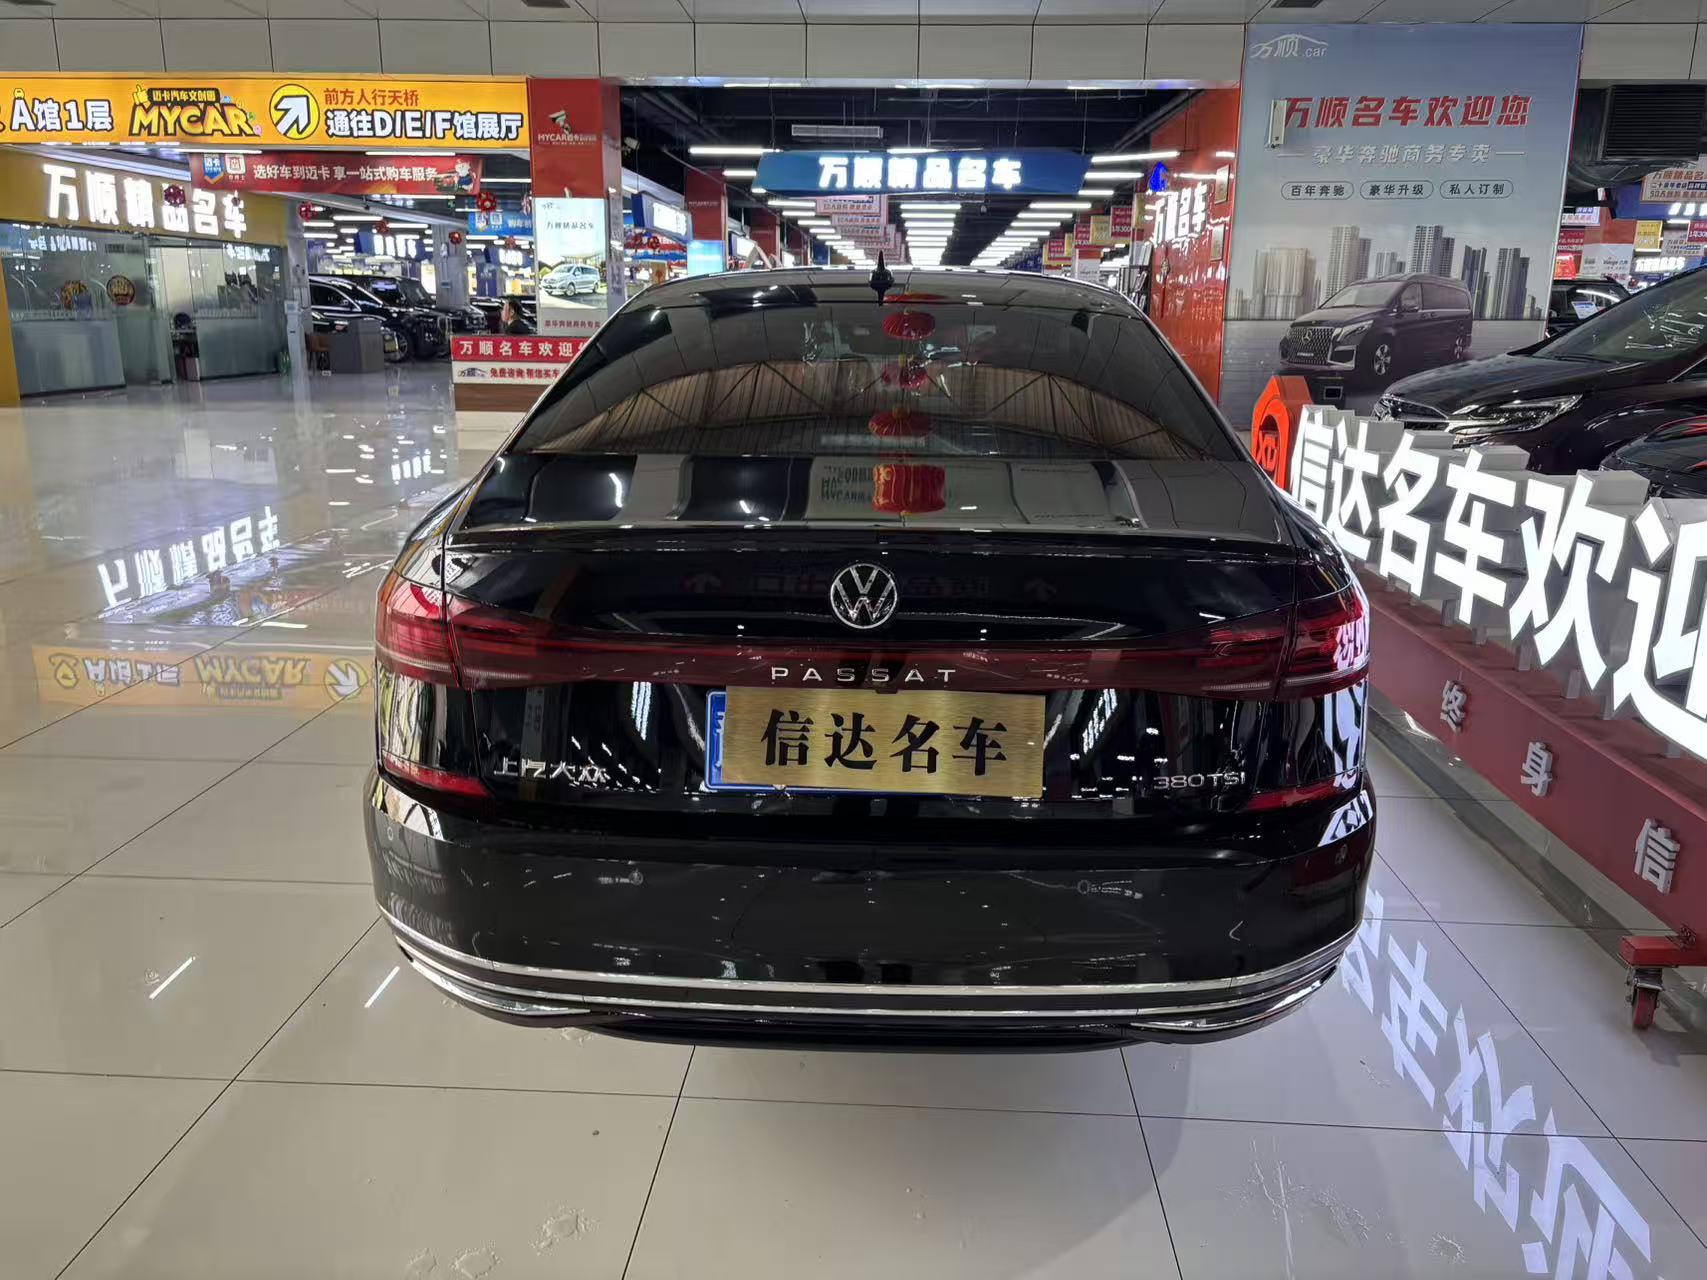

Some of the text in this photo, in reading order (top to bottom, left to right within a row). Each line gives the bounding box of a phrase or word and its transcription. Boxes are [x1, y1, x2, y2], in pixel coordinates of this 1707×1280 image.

[323, 88, 419, 107] 前方人行天桥
[10, 97, 113, 131] A馆1层
[131, 104, 256, 136] MYCAR
[1286, 95, 1532, 128] 万顺名车欢迎您
[1312, 144, 1490, 165] 豪华奔驰商务专卖
[253, 164, 437, 181] 选好车到迈卡 享一站式购车服务
[1291, 185, 1345, 197] 百年奔驰
[1369, 184, 1424, 196] 豪华升级
[1449, 183, 1504, 196] 私人订制
[770, 666, 957, 683] PASSAT
[760, 709, 1008, 777] 信达名车
